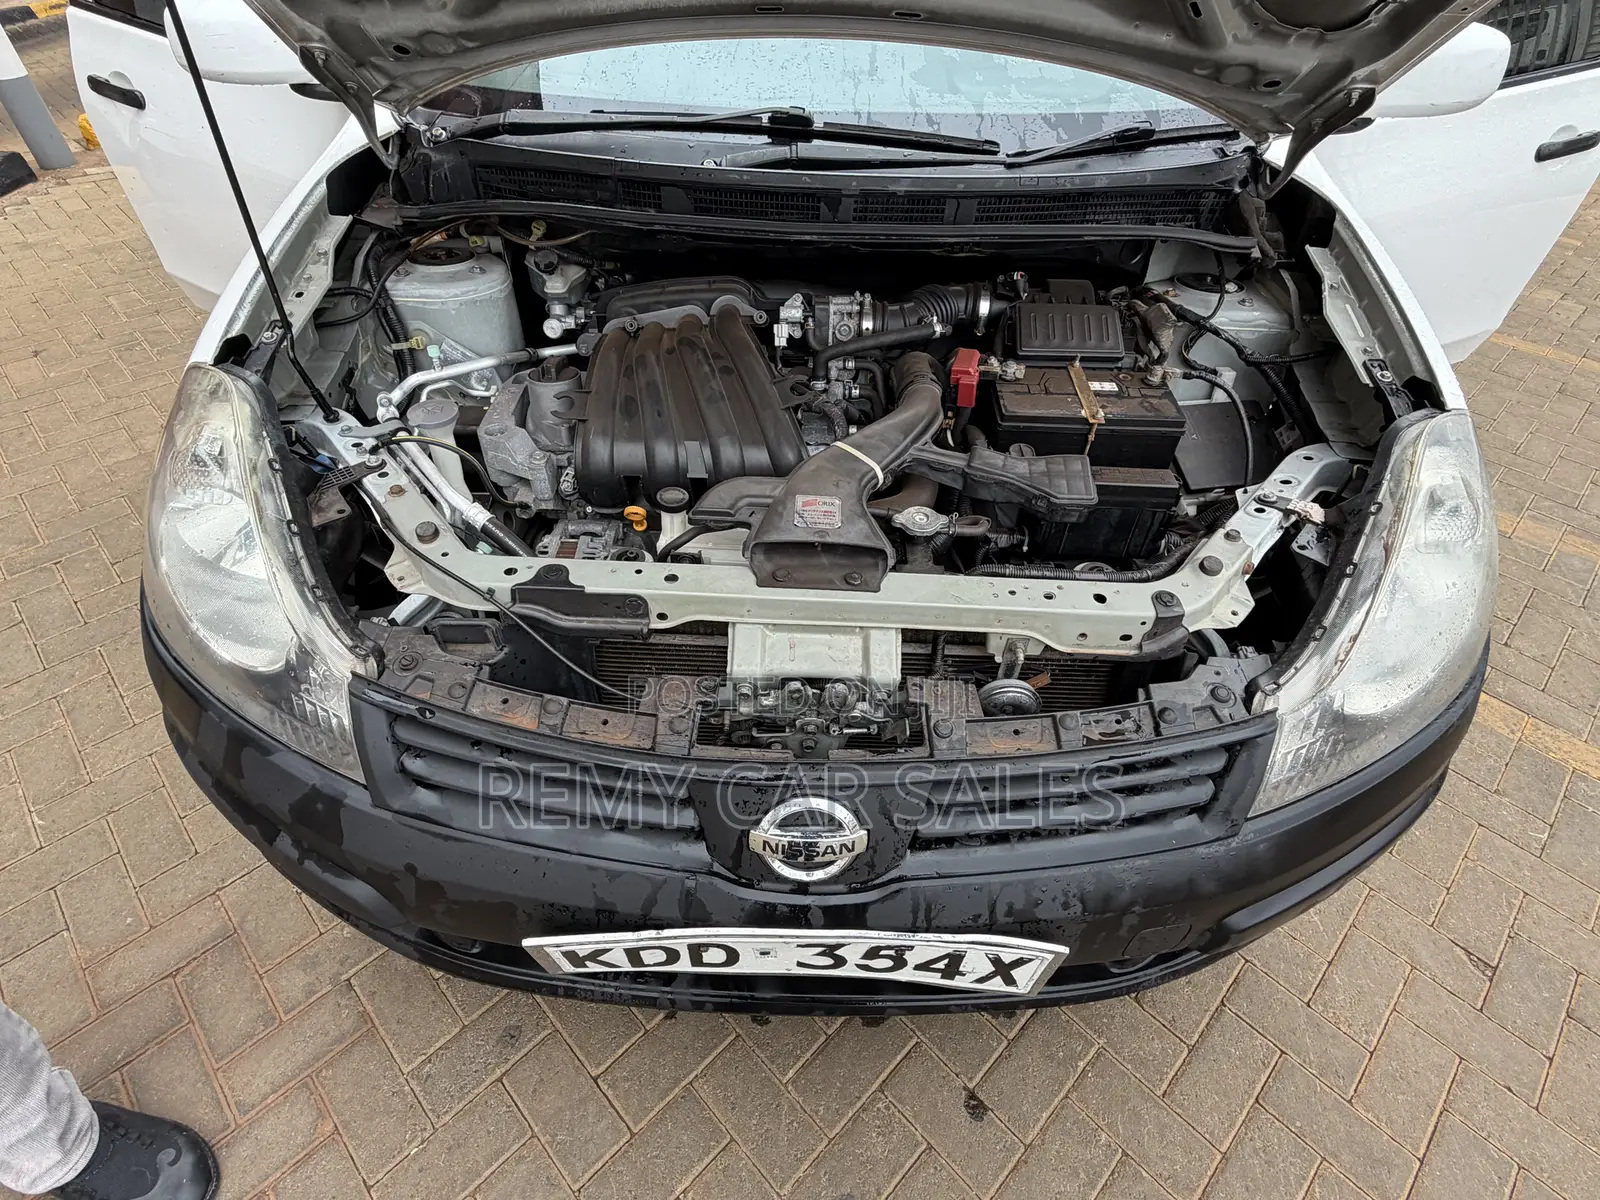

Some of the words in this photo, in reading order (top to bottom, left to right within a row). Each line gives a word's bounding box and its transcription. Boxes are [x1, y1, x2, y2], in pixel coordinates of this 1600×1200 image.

[762, 840, 856, 859] NISSAN
[567, 942, 741, 970] KDD
[795, 943, 1038, 989] 354X
